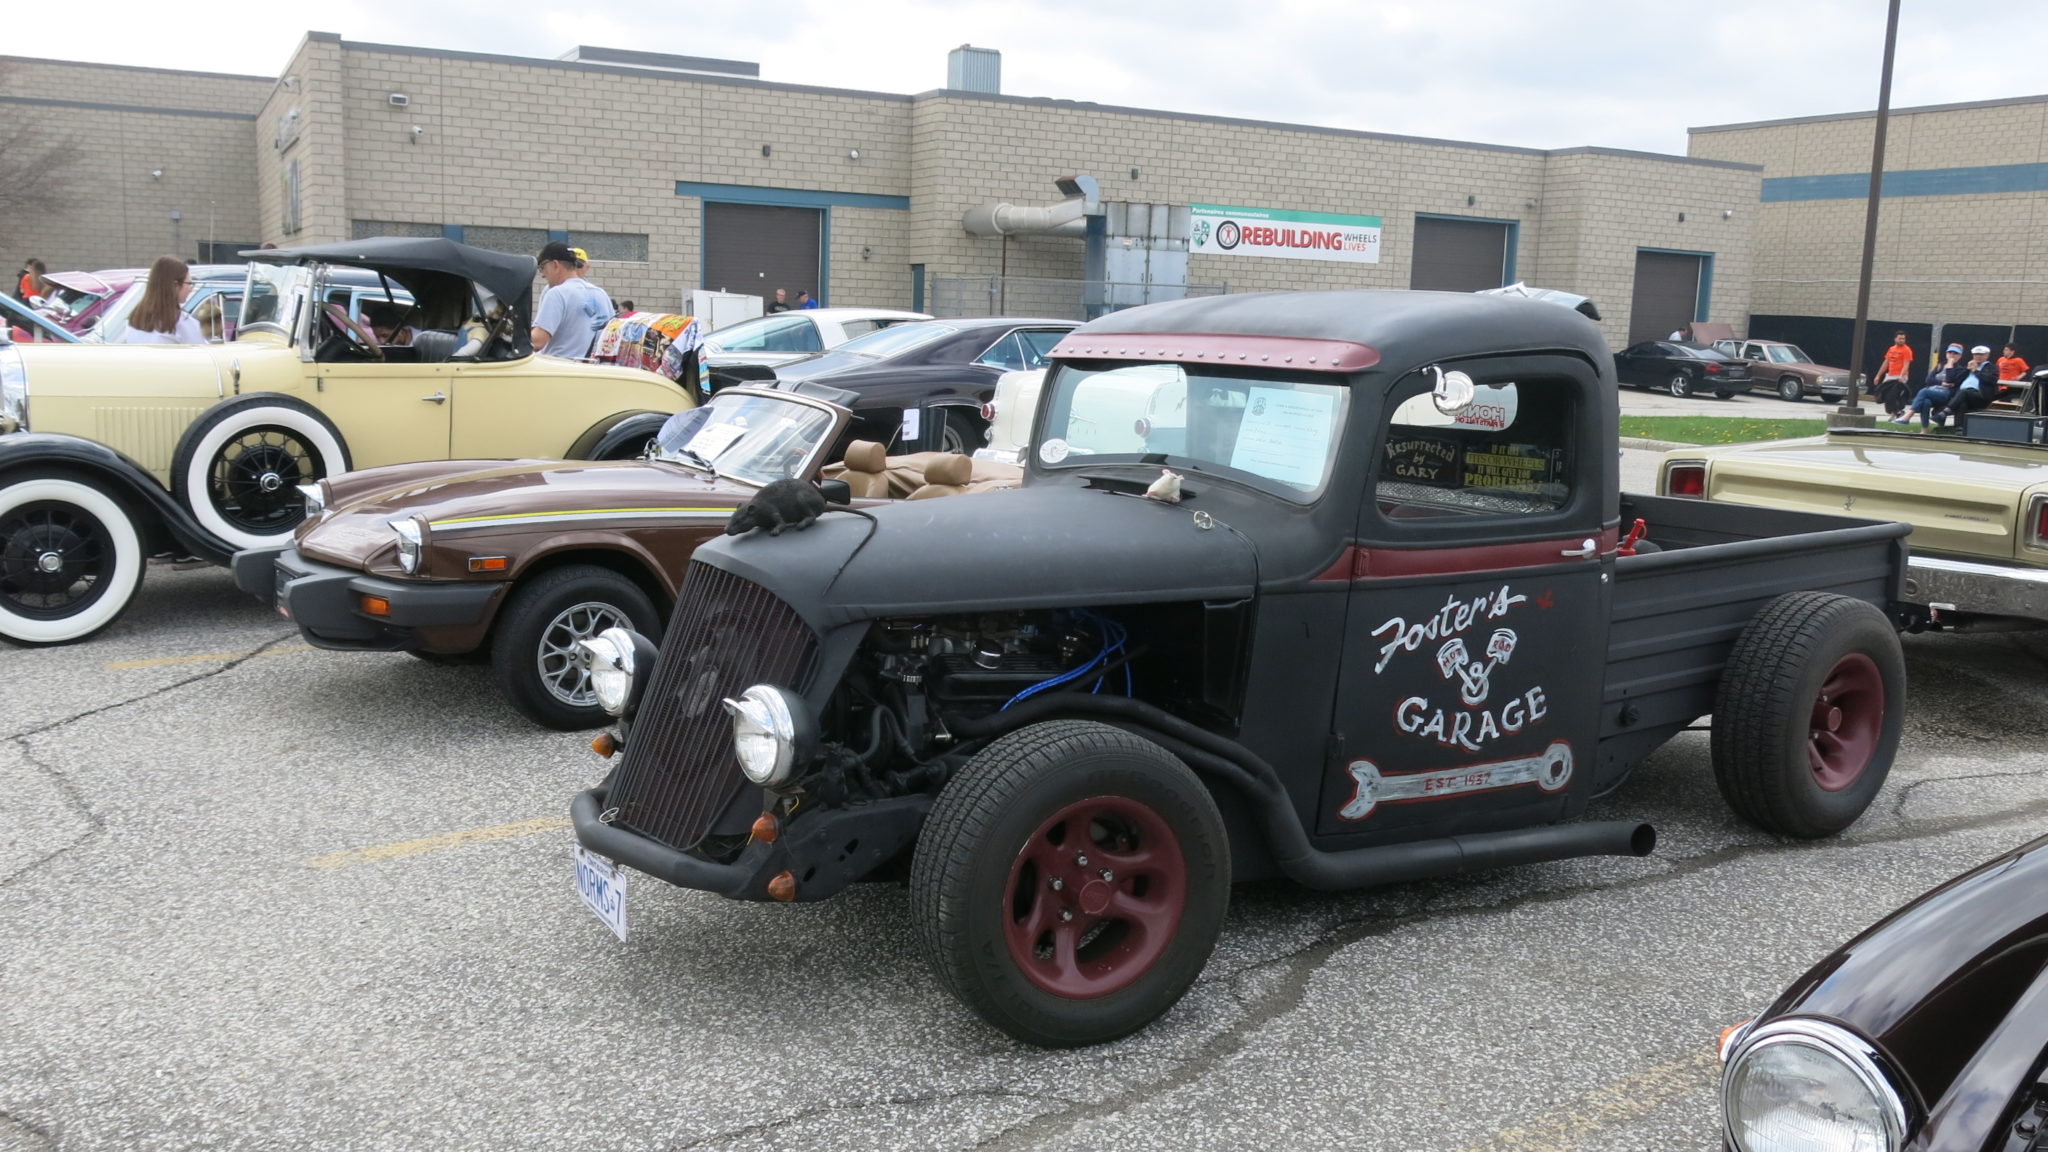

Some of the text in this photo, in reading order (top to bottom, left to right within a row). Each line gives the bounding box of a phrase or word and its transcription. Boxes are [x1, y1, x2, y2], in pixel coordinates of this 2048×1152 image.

[1241, 225, 1377, 251] REBUILDING WHEELS
[1343, 242, 1367, 252] LIVES
[1412, 451, 1426, 466] by
[1395, 463, 1440, 480] GARY
[1371, 584, 1528, 675] Foster's
[1493, 639, 1512, 652] ROD
[1442, 647, 1463, 667] HOT
[1397, 686, 1548, 751] GARAGE
[575, 858, 610, 914] NORMS
[615, 888, 622, 925] 7
